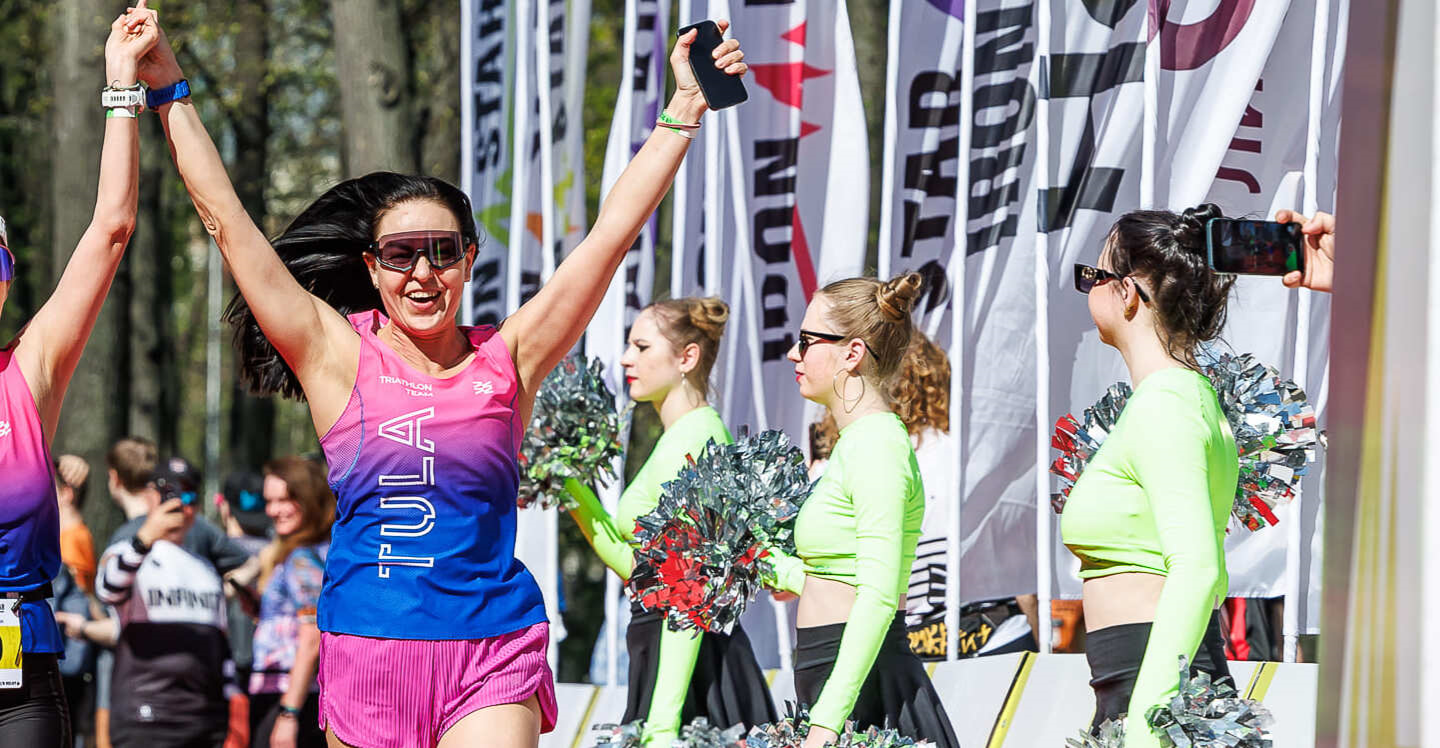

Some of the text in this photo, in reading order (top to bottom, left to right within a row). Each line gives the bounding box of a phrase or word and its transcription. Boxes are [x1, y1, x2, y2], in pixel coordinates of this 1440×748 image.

[967, 3, 1036, 257] IRON
[379, 376, 432, 391] TRIATHLON
[406, 388, 433, 397] TEAM
[378, 406, 436, 578] TULA
